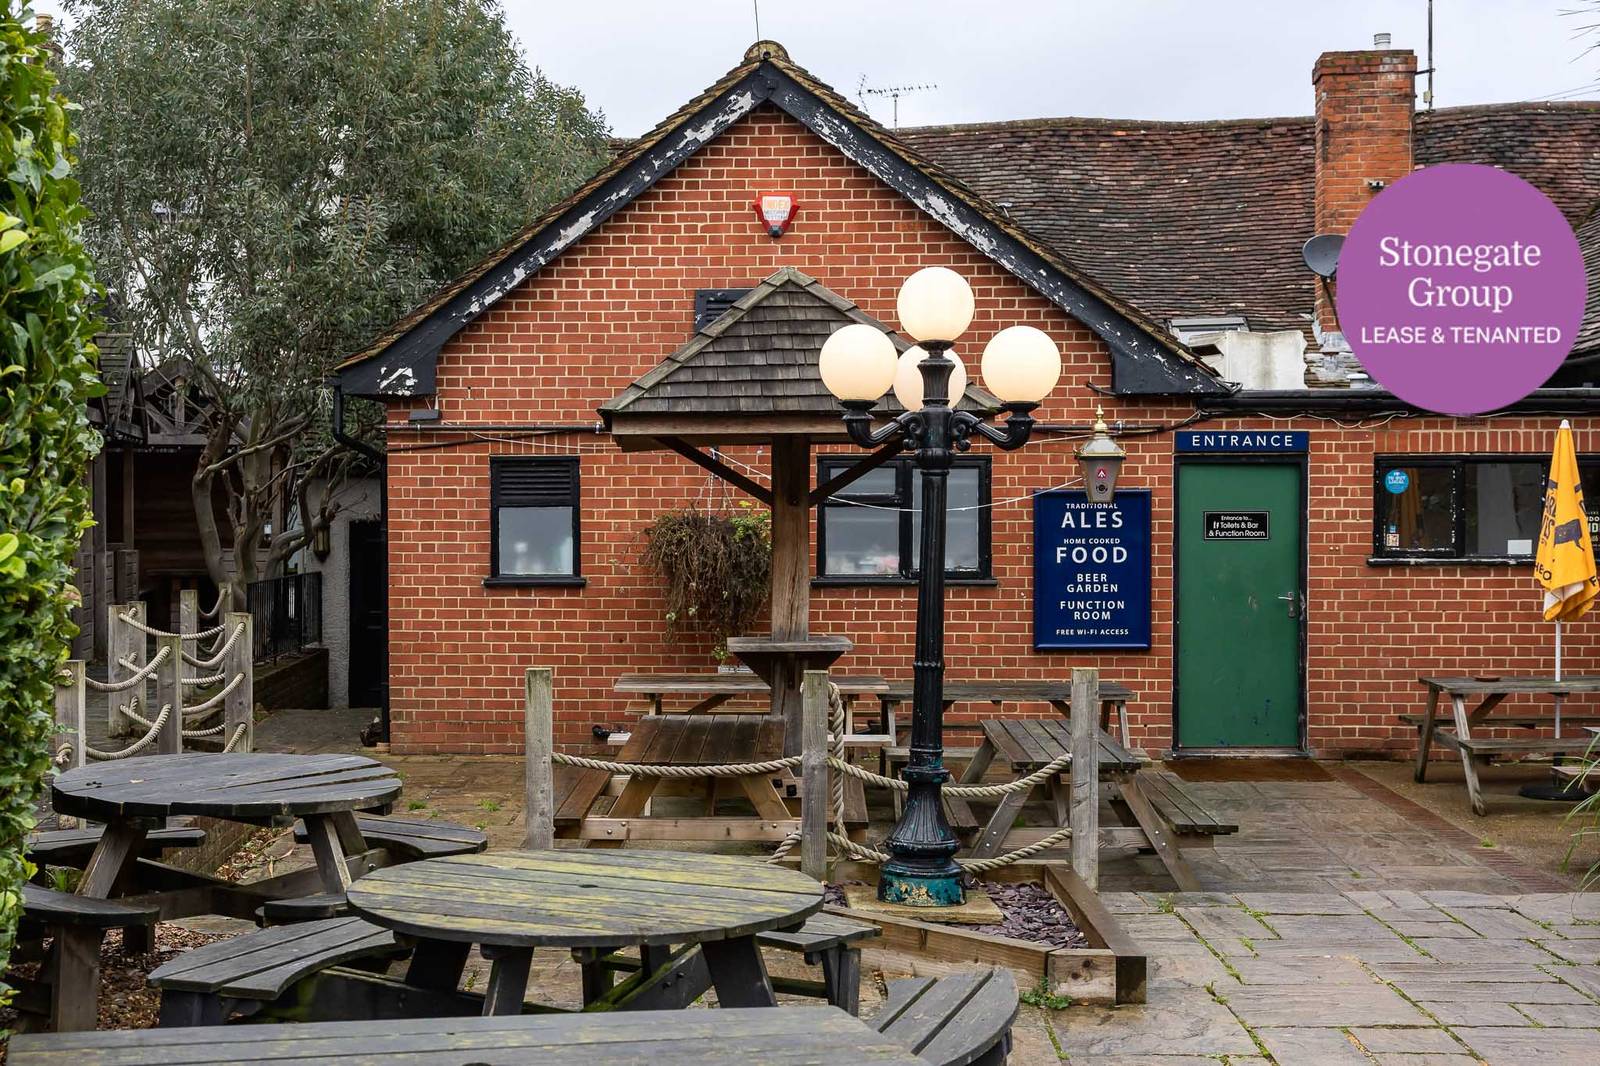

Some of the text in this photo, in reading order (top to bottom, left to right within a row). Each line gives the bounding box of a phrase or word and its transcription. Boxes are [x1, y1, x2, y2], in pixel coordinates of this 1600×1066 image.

[1192, 435, 1293, 447] ENTRANCE
[1061, 511, 1123, 528] ALES
[1056, 546, 1128, 564] FOOD
[1076, 573, 1107, 583] BEER
[1066, 583, 1118, 593] GARDEN
[1060, 600, 1125, 610] FUNCTION
[1074, 611, 1111, 620] ROOM
